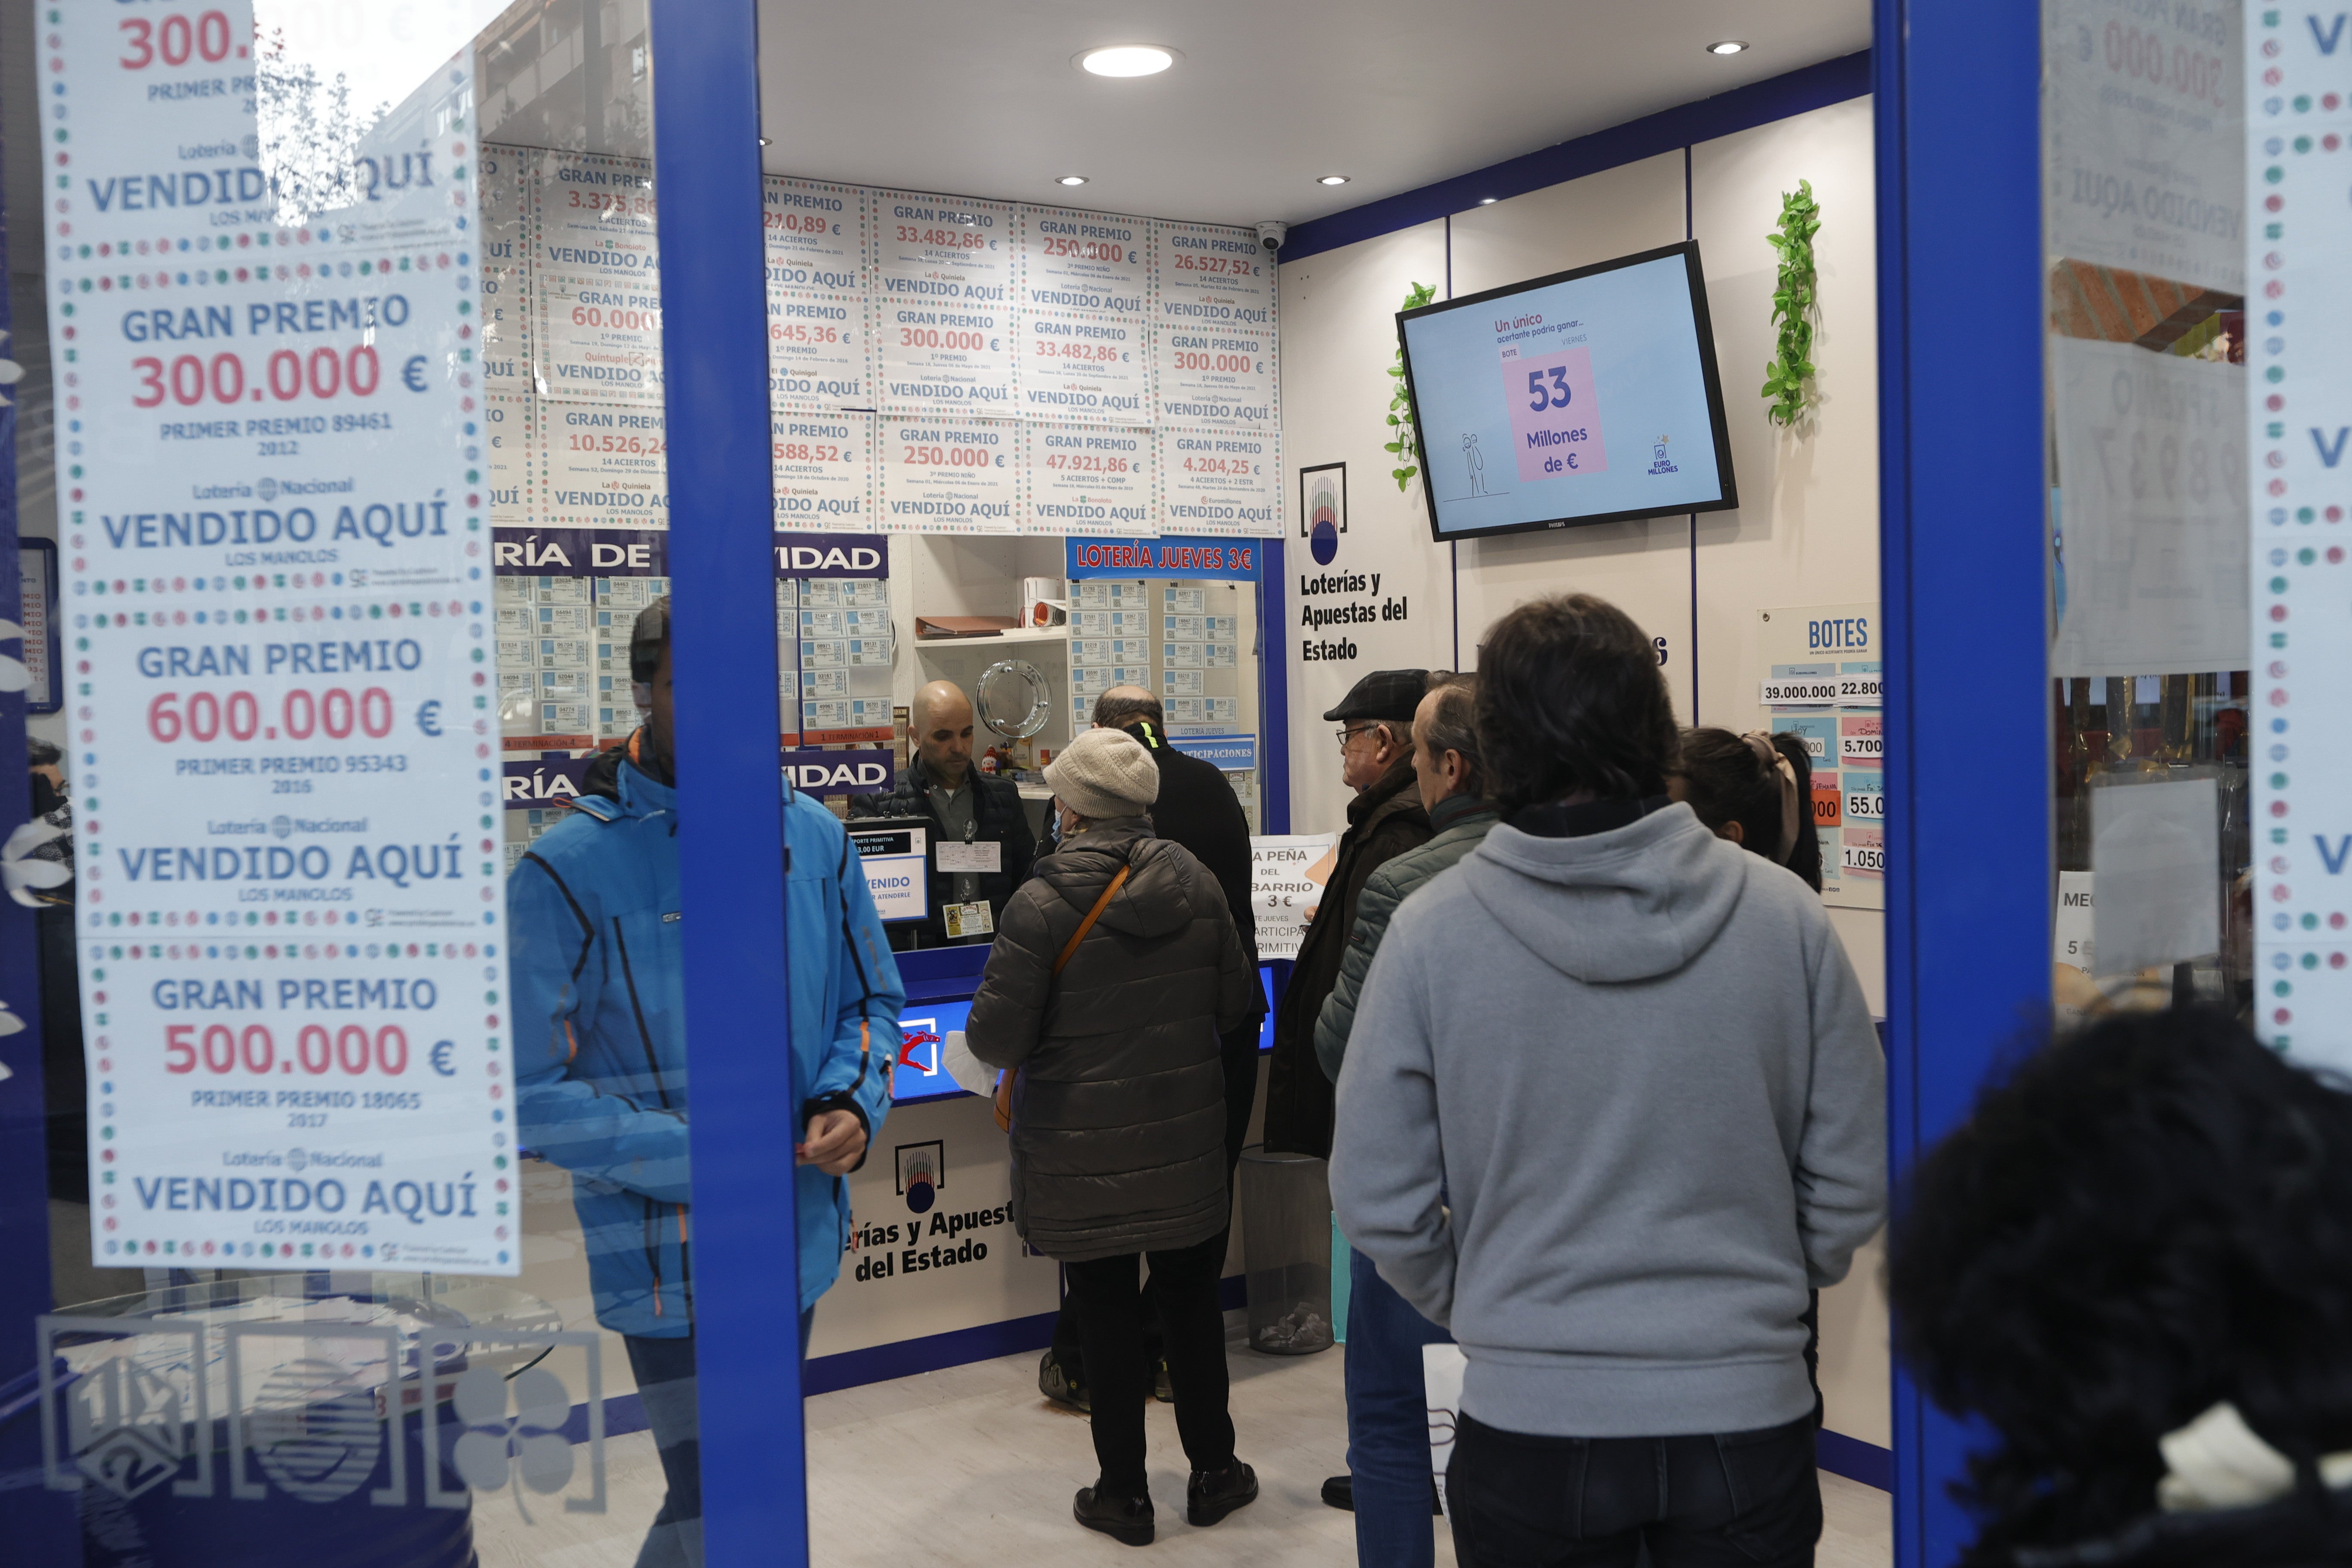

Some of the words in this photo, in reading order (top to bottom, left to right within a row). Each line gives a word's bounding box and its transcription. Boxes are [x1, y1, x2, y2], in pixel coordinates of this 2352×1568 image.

[148, 79, 226, 101] PRIMER
[88, 167, 275, 211] VENDID
[784, 193, 842, 211] PREMIO
[894, 206, 933, 220] GRAN
[939, 211, 992, 227] PREMIO
[897, 226, 984, 250] 33.482,86
[989, 240, 997, 250] €
[1040, 221, 1076, 235] GRAN
[1081, 225, 1131, 241] PREMIO
[1174, 254, 1249, 275] 26.527,52
[1253, 266, 1259, 276] €
[884, 276, 959, 296] VENDIDO
[964, 284, 1003, 301] AQUÍ
[122, 306, 233, 343] GRAN
[247, 294, 410, 336] PREMIO
[787, 305, 846, 320] PREMIO
[1494, 319, 1510, 333] Un
[1513, 314, 1543, 329] único
[770, 324, 836, 344] 645,36
[842, 333, 850, 344] €
[900, 328, 983, 350] 300.000
[990, 339, 999, 351] €
[1497, 330, 1530, 343] acertante
[1562, 334, 1587, 345] VIERNES
[1502, 349, 1517, 358] BOTE
[132, 345, 379, 408] 300.000
[401, 355, 428, 392] €
[557, 364, 641, 381] VENDIDO
[1529, 366, 1571, 412] 53
[1028, 391, 1097, 406] VENDIDO
[1102, 394, 1139, 411] AQUÍ
[160, 420, 237, 440] PRIMER
[246, 416, 327, 436] PREMIO
[332, 412, 392, 432] 89461
[566, 413, 612, 426] GRAN
[790, 424, 848, 438] PREMIO
[900, 429, 940, 442] GRAN
[945, 431, 998, 444] PREMIO
[1527, 428, 1587, 448] Millones
[1046, 435, 1081, 448] GRAN
[1087, 438, 1136, 451] PREMIO
[1177, 439, 1211, 450] GRAN
[1216, 441, 1261, 454] PREMIO
[904, 446, 988, 467] 250.000
[995, 455, 1004, 467] €
[1047, 455, 1127, 474] 47.921,86
[1133, 463, 1139, 473] €
[1183, 457, 1249, 476] 4.204,25
[1254, 465, 1260, 475] €
[1544, 456, 1562, 472] de
[1567, 453, 1578, 469] €
[1648, 465, 1678, 475] MILLONES
[280, 478, 355, 495] Nacional
[555, 491, 644, 507] VENDIDO
[101, 507, 316, 548] VENDIDO
[332, 489, 447, 547] AQUÍ
[891, 501, 965, 515] VENDIDO
[970, 501, 1009, 519] AQUÍ
[1170, 505, 1234, 519] VENDIDO
[1238, 505, 1271, 522] AQUÍ
[592, 543, 650, 567] DE
[1077, 539, 1153, 568] LOTERÍA
[1158, 546, 1222, 570] JUEVES
[1228, 548, 1252, 570] 3€
[1301, 570, 1366, 595] Loterías
[1371, 573, 1380, 597] y
[1302, 601, 1376, 631] Apuestas
[1382, 596, 1407, 621] del
[1809, 618, 1867, 648] BOTES
[137, 645, 249, 678] GRAN
[265, 638, 422, 674] PREMIO
[1303, 637, 1357, 661] Estado
[1766, 686, 1835, 698] 39.000.000
[148, 687, 393, 743] 600.000
[416, 699, 443, 737] €
[514, 739, 567, 747] TERMINACIÓN
[176, 758, 255, 775] PRIMER
[260, 756, 340, 774] PREMIO
[345, 754, 408, 772] 95343
[118, 845, 331, 881] VENDIDO
[346, 833, 463, 888] AQUÍ
[1268, 848, 1307, 861] PEÑA
[1268, 895, 1277, 907] 3
[1283, 896, 1292, 907] €
[1255, 927, 1304, 936] ARTICIPA
[2067, 941, 2077, 954] 5
[152, 979, 263, 1010] GRAN
[278, 979, 437, 1011] PREMIO
[165, 1024, 408, 1075] 500.000
[429, 1040, 456, 1077] €
[192, 1090, 270, 1107] PRIMER
[276, 1090, 356, 1108] PREMIO
[361, 1091, 421, 1110] 18065
[134, 1177, 346, 1213] VENDIDO
[361, 1171, 477, 1225] AQUÍ
[907, 1221, 921, 1246] y
[929, 1200, 1014, 1239] Apuest
[856, 1252, 893, 1282] del
[902, 1238, 987, 1274] Estado
